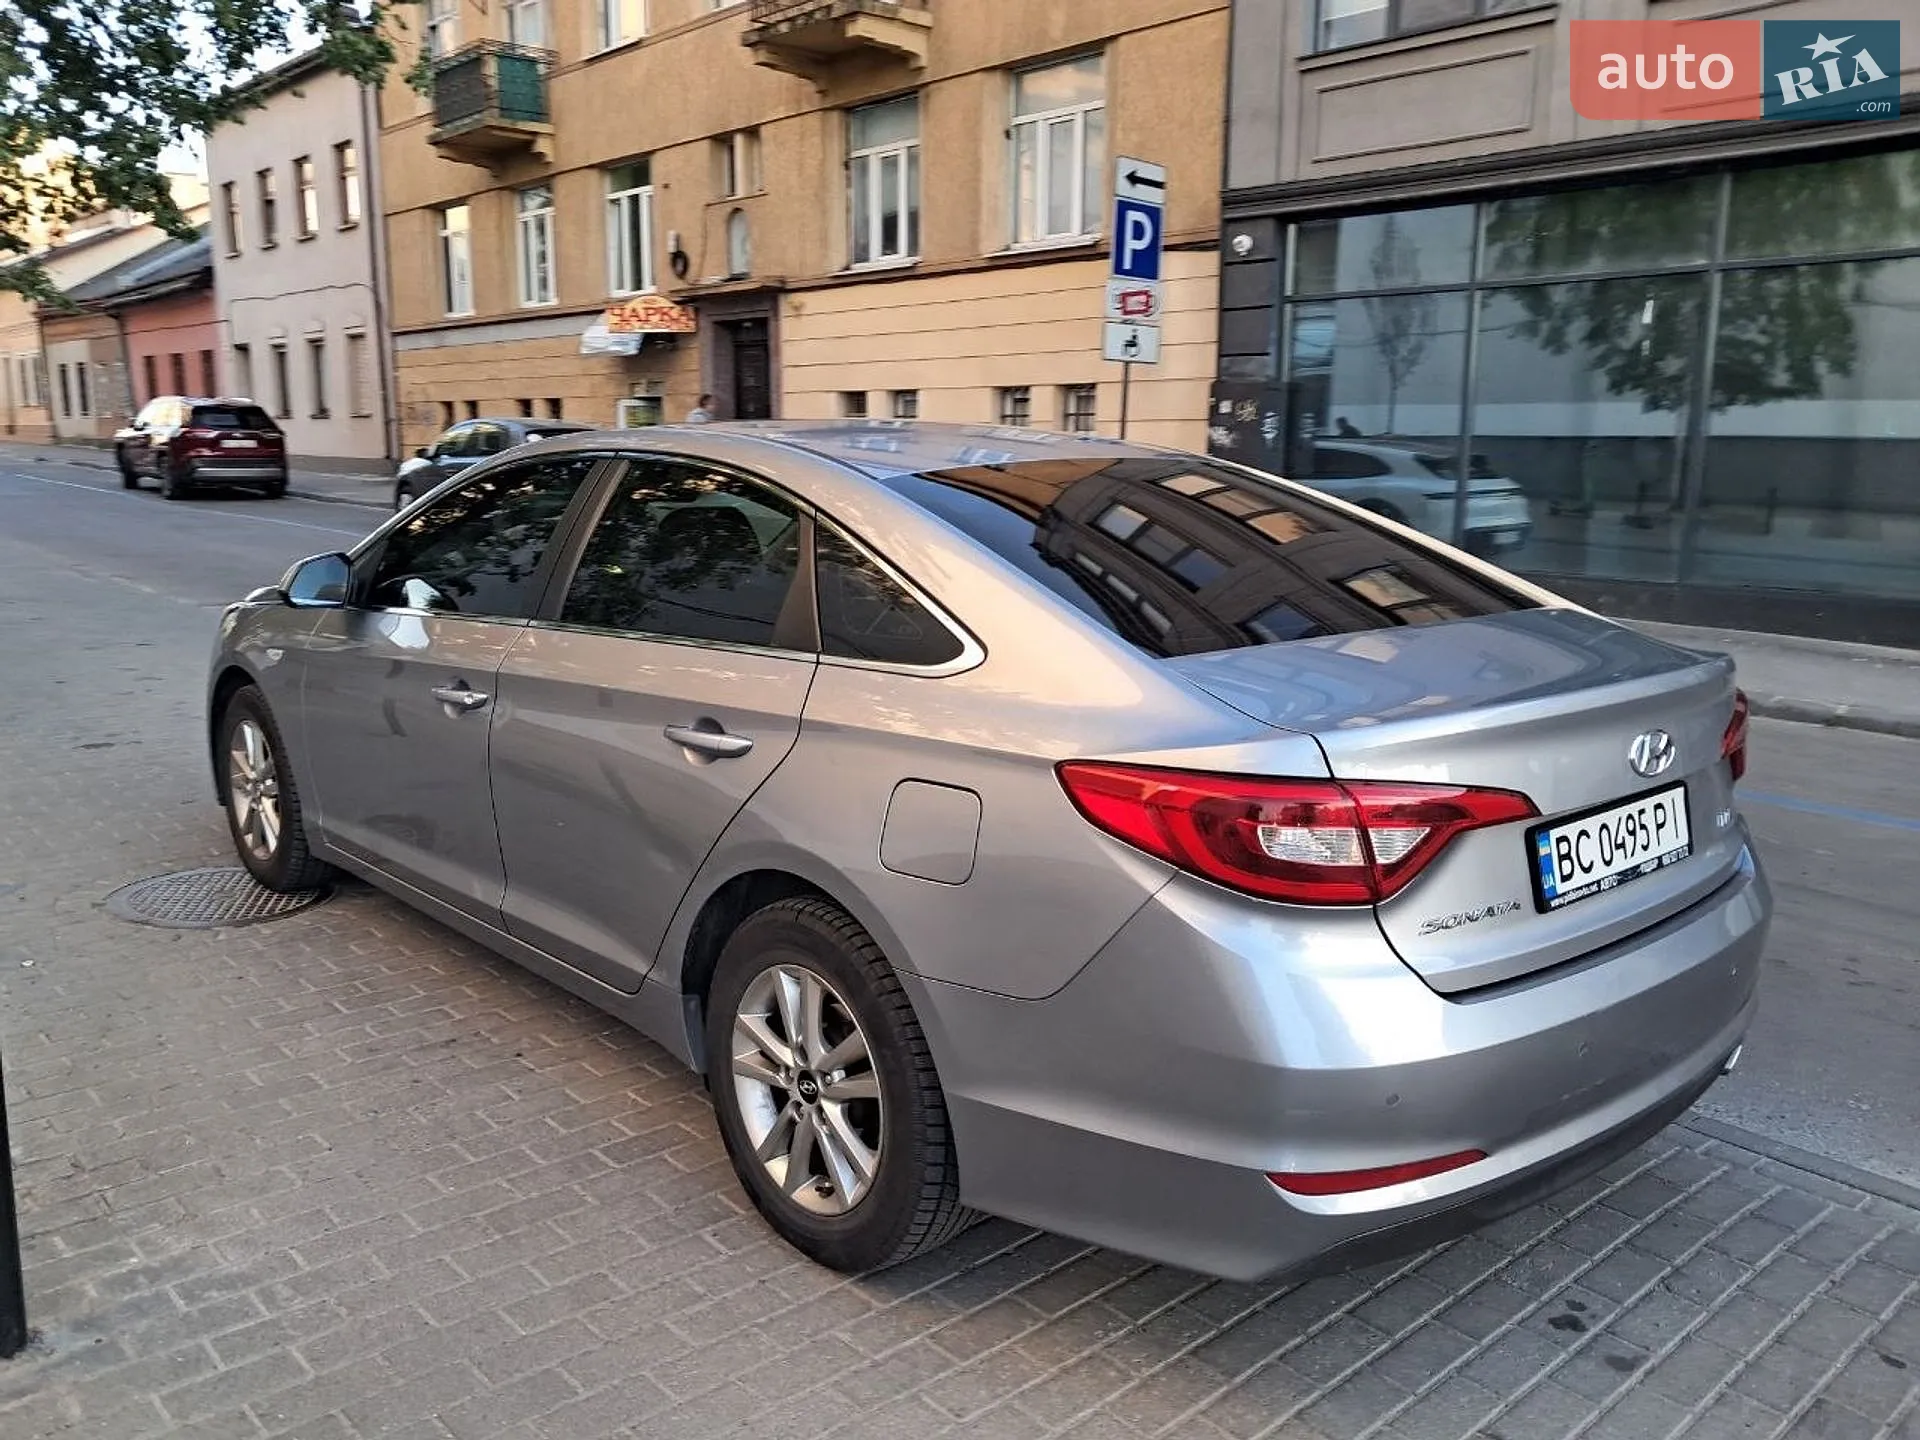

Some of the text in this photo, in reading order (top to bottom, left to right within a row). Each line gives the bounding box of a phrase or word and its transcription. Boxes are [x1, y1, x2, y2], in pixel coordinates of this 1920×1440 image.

[1122, 210, 1153, 270] P
[607, 304, 695, 323] ЧАРКА
[1555, 829, 1594, 883] BC
[1598, 808, 1650, 867] 0495
[1543, 873, 1555, 889] UA
[1418, 901, 1521, 936] SONATA
